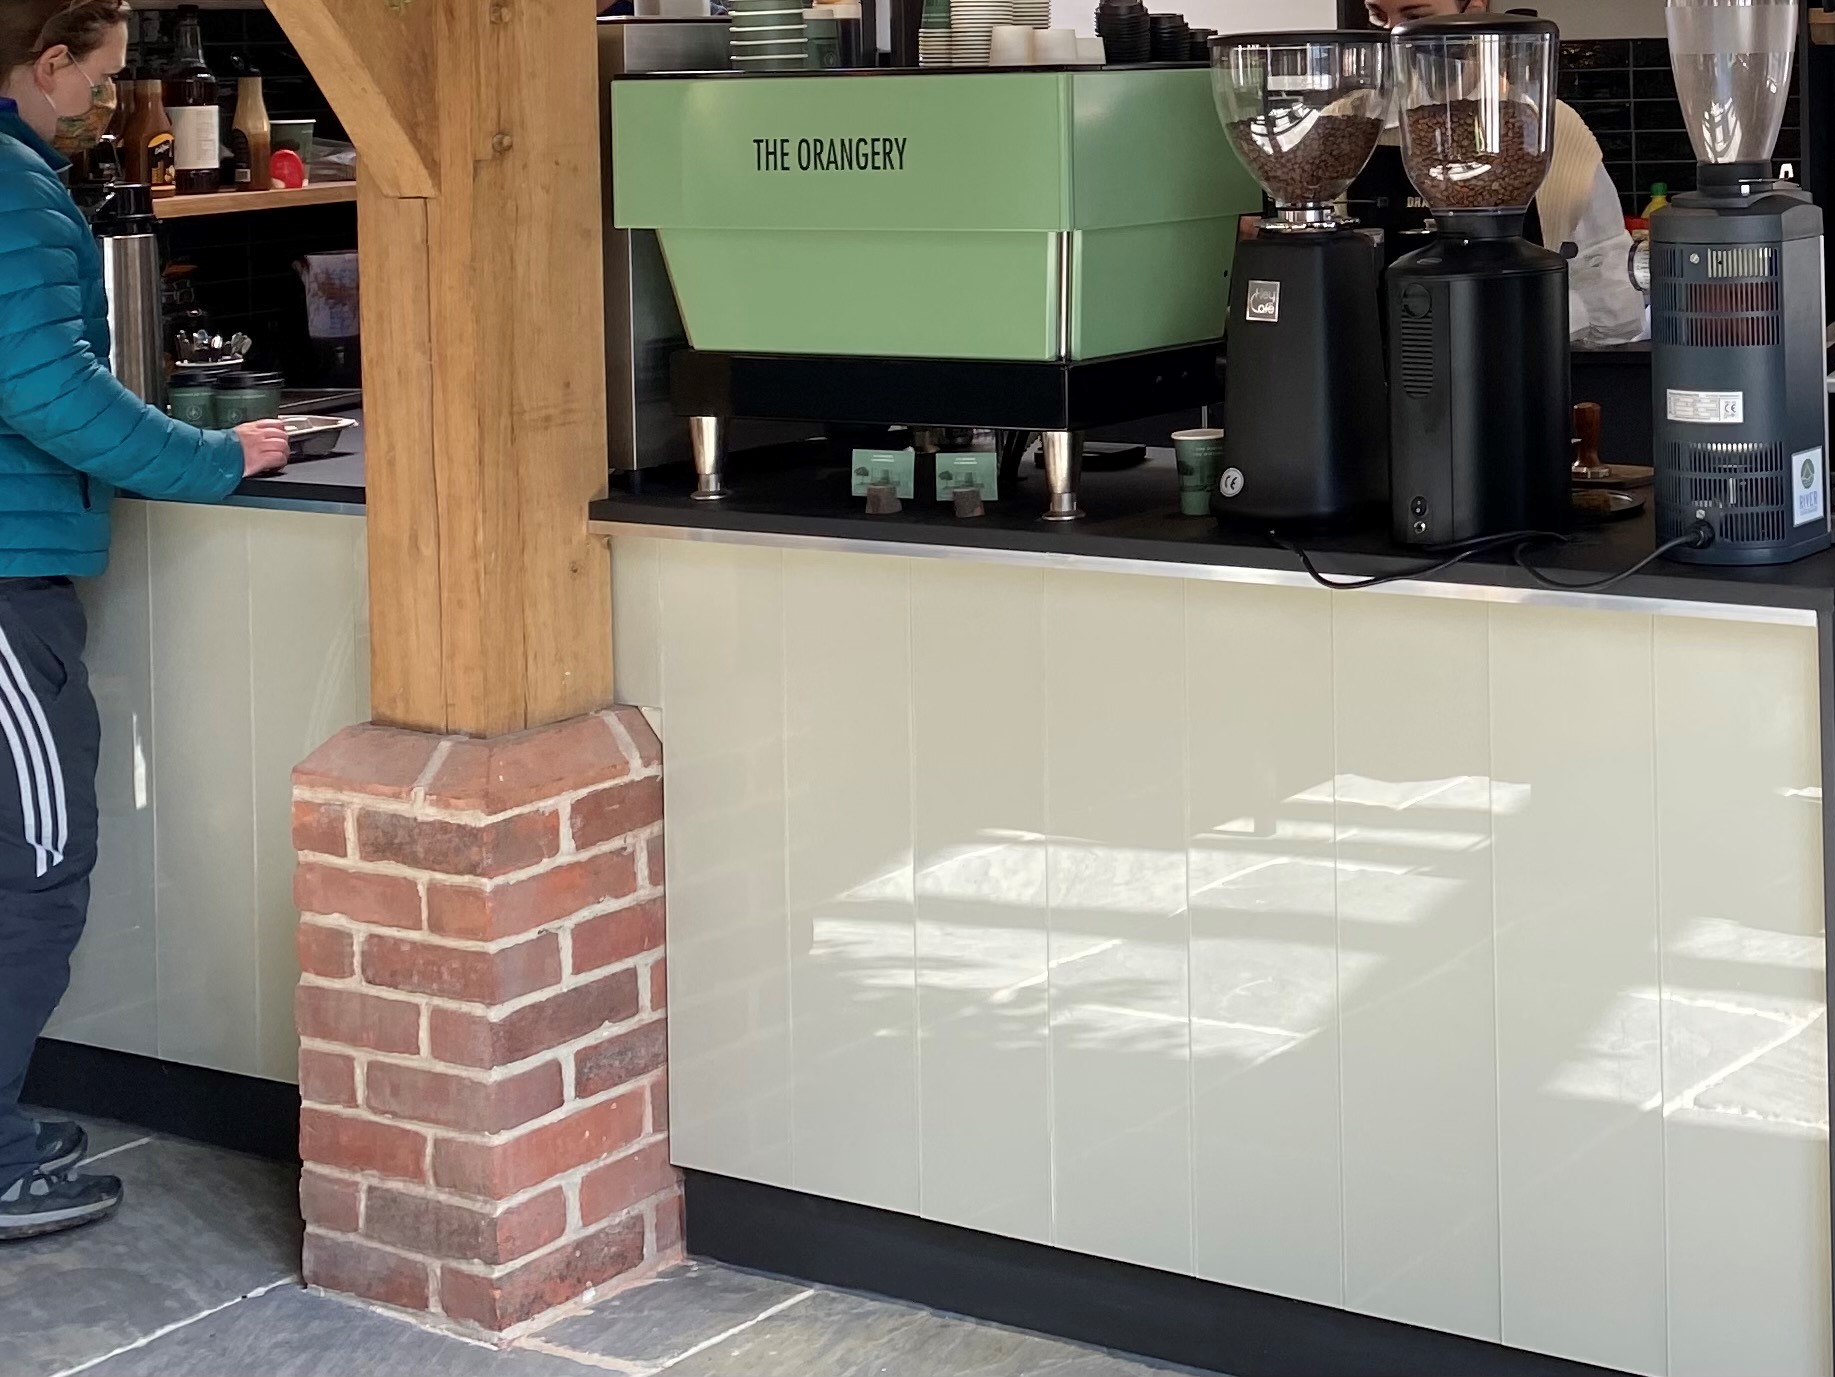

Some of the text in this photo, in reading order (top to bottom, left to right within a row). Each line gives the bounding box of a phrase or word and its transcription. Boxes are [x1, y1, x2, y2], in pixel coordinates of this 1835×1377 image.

[753, 137, 907, 171] THE ORANGERY
[1799, 490, 1818, 510] RIVER
